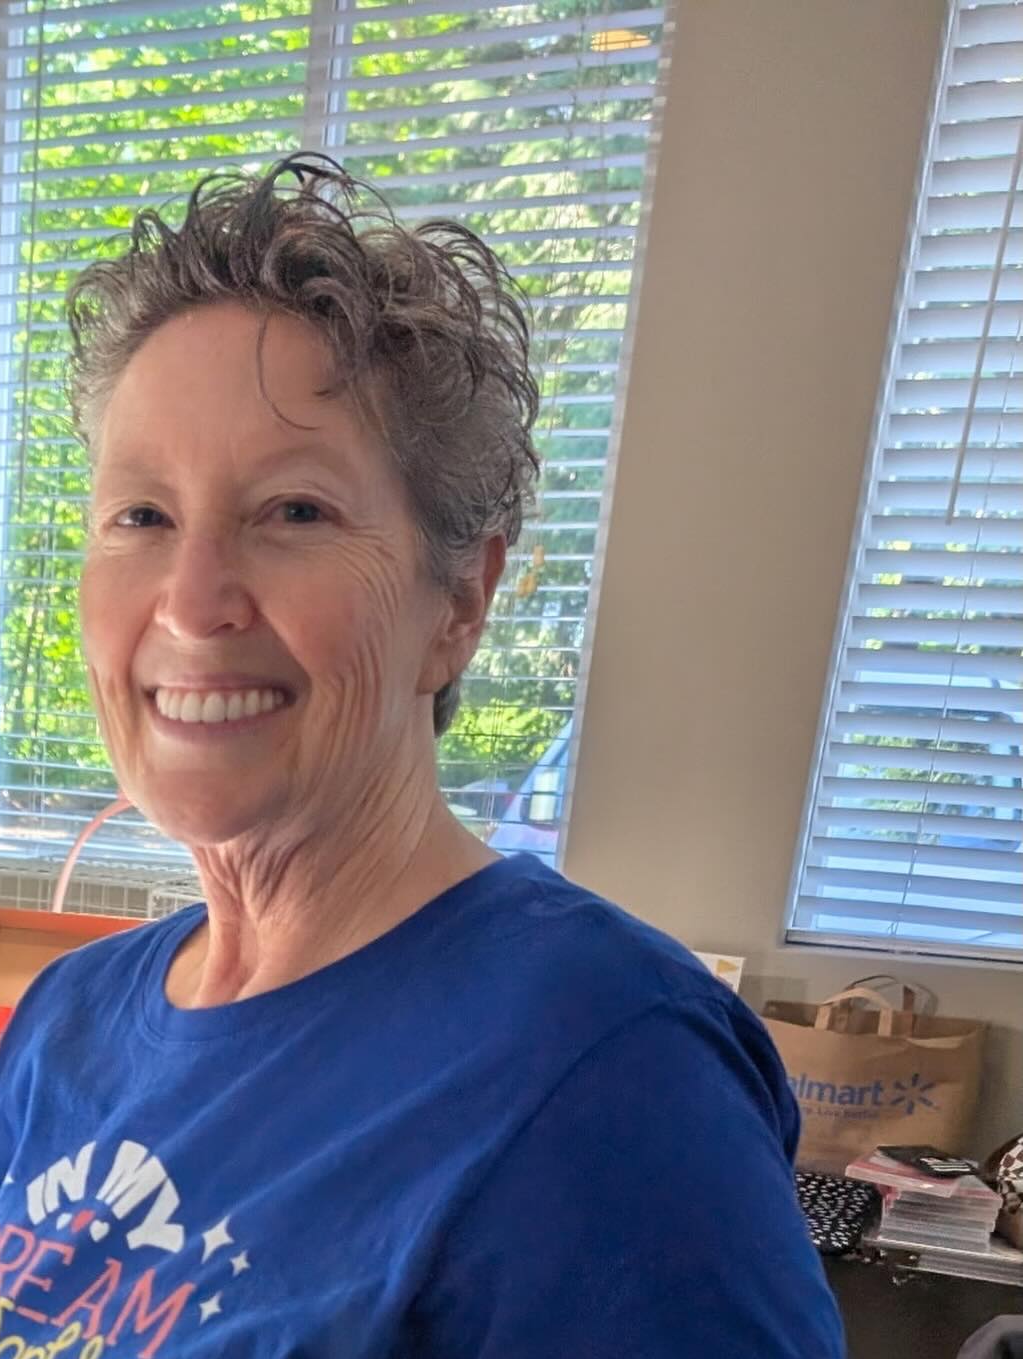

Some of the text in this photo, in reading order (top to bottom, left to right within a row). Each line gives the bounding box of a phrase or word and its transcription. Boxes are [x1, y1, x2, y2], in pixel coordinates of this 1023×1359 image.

[787, 1073, 884, 1105] almart
[27, 1139, 185, 1253] IN MY
